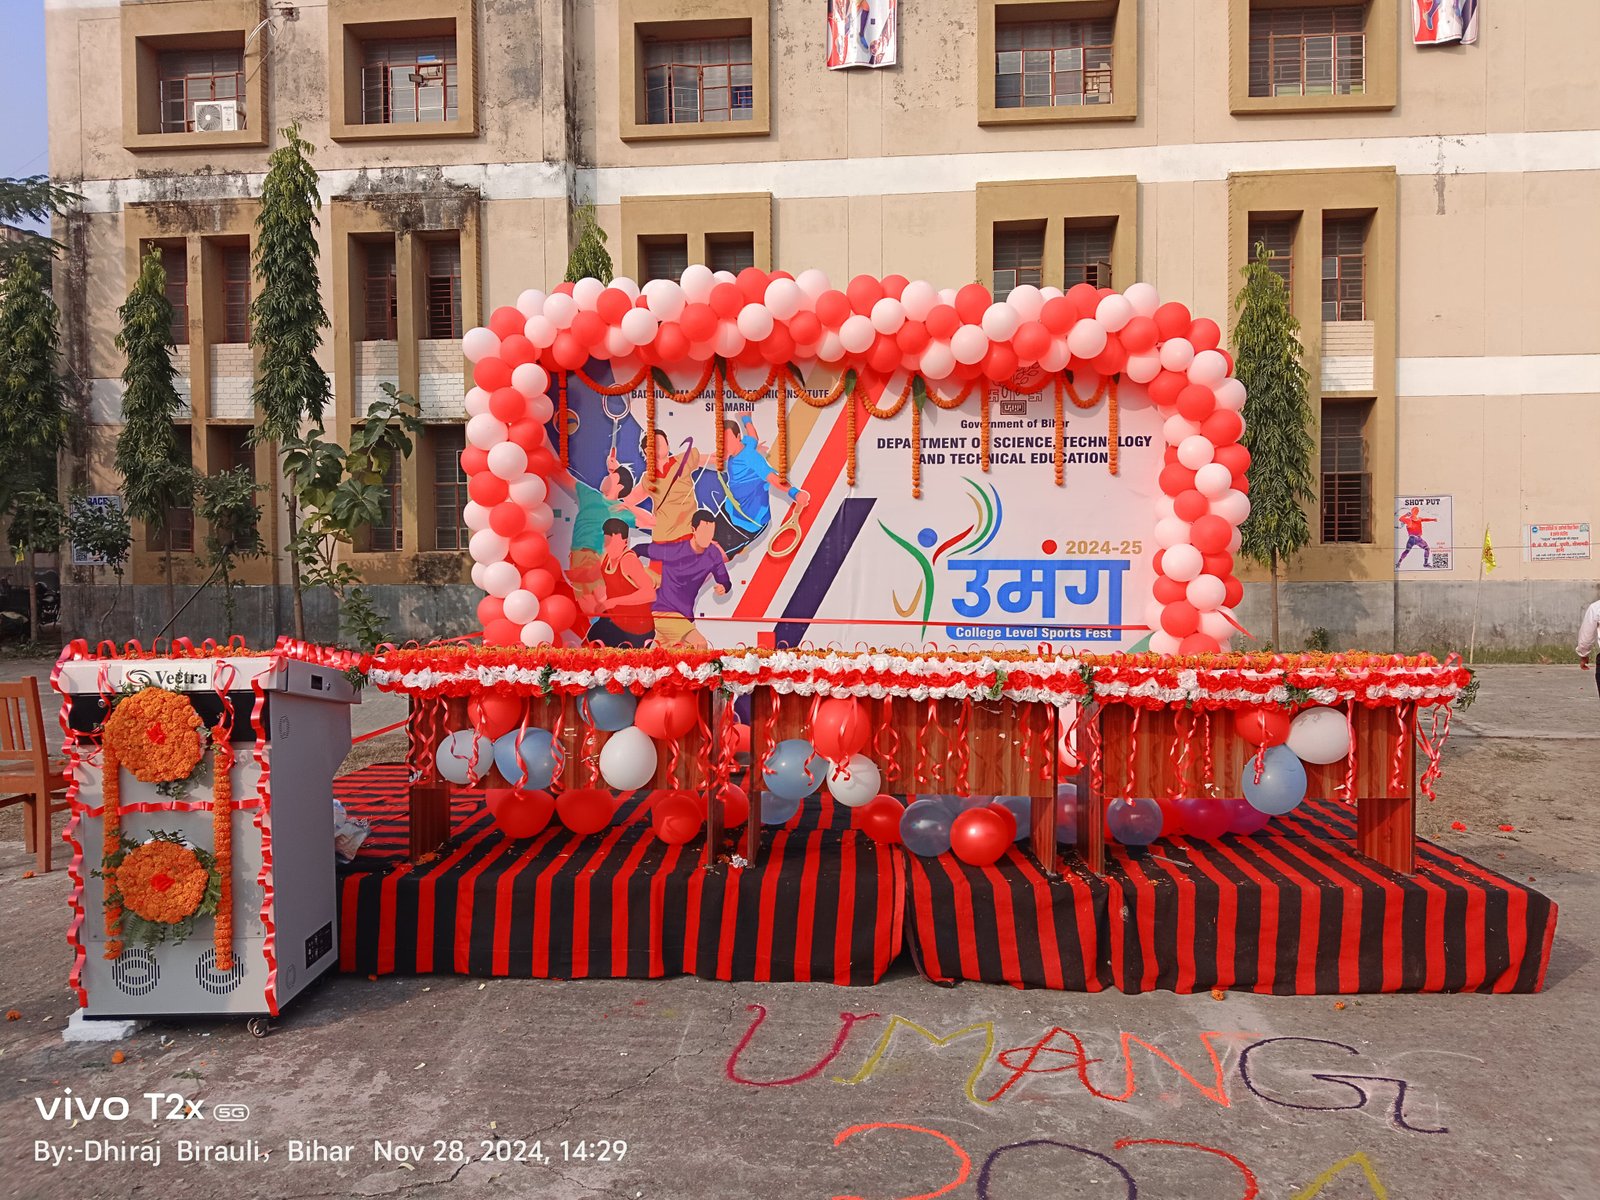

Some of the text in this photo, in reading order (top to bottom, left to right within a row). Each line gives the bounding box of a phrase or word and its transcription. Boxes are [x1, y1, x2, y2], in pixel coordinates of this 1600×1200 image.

[705, 402, 755, 412] SIMARHI
[960, 419, 1070, 429] Govnment of Bihr
[877, 438, 967, 449] DEPATMENT
[993, 436, 1057, 450] SCIENCE,
[1062, 436, 1152, 448] TECHNLOGY
[919, 453, 946, 465] AND
[1426, 498, 1441, 506] PUT
[1065, 540, 1143, 555] 2024-25
[947, 539, 1131, 626] उमंग
[955, 627, 1112, 639] College Level Sports Fest
[726, 1003, 1450, 1134] UMANG
